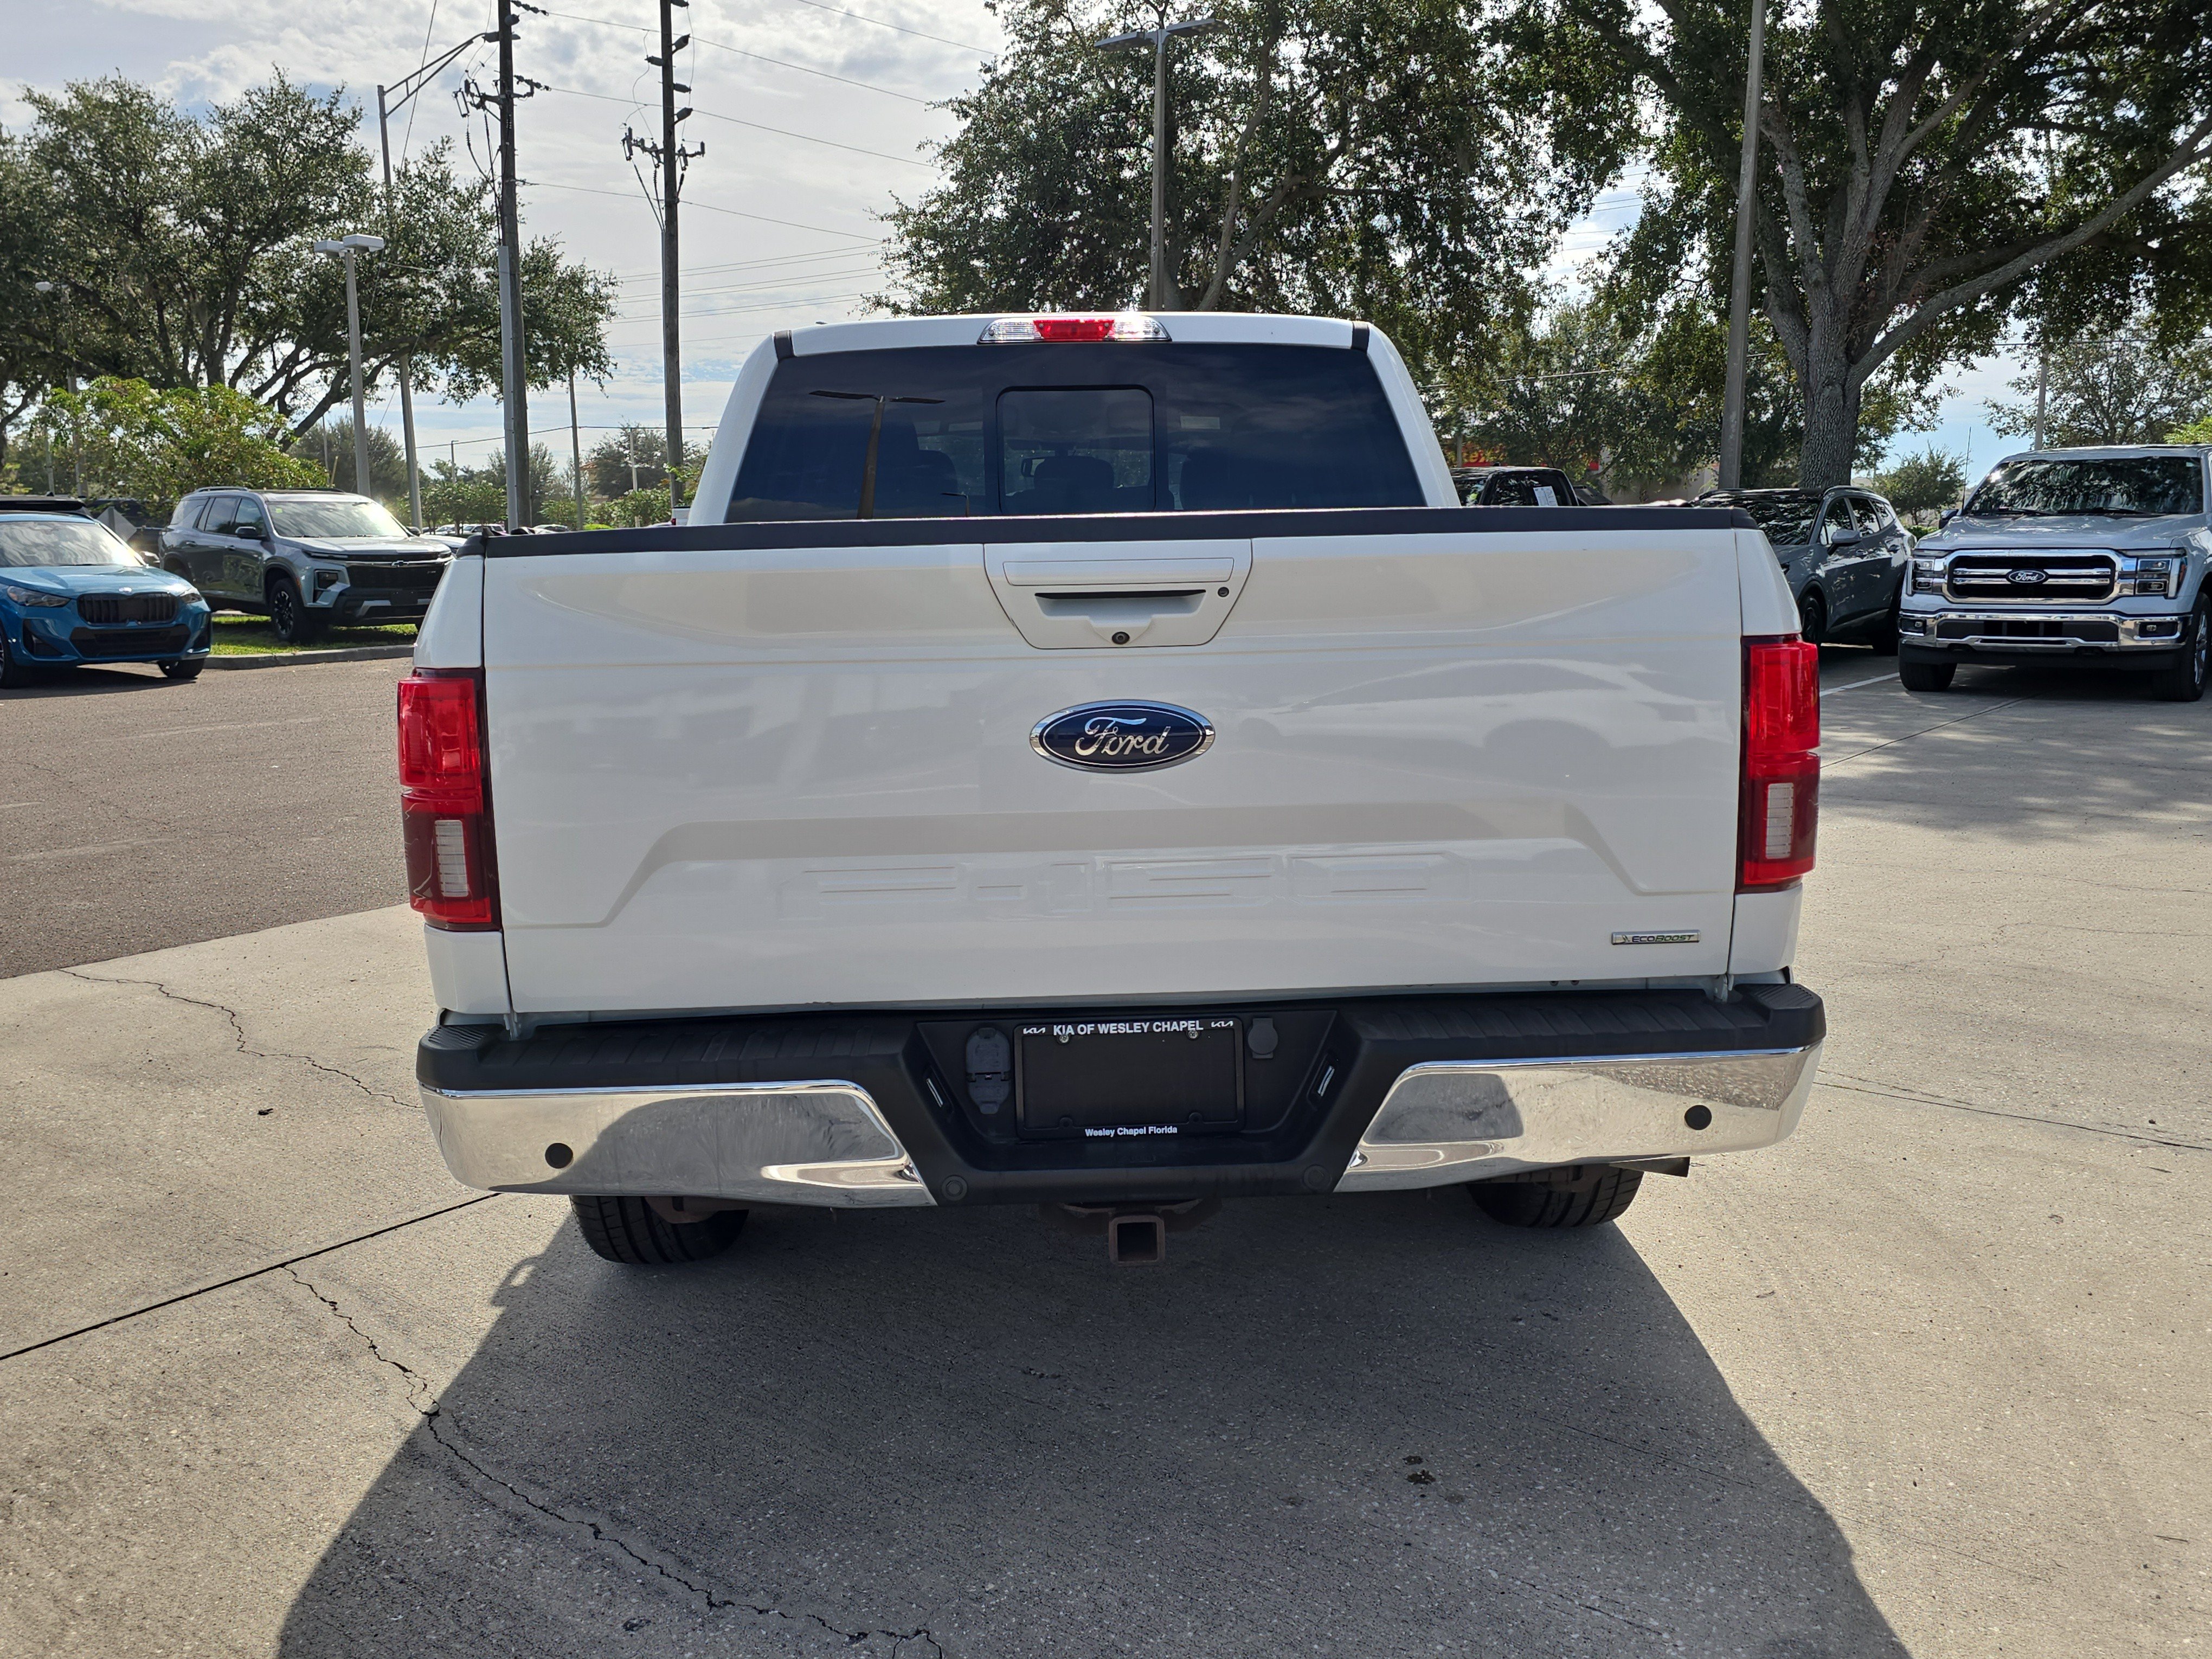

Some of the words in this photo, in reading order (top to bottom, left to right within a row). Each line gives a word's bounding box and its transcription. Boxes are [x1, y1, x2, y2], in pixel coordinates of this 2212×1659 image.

[2015, 572, 2039, 581] Ford
[1075, 717, 1171, 756] Ford
[1053, 1025, 1075, 1036] KIA
[1077, 1024, 1095, 1035] OF
[1097, 1022, 1150, 1034] WESLEY
[1152, 1020, 1204, 1032] CHAPEL
[1085, 1128, 1115, 1137] Wesley
[1117, 1127, 1147, 1136] Chapel
[1148, 1126, 1178, 1134] Florida
